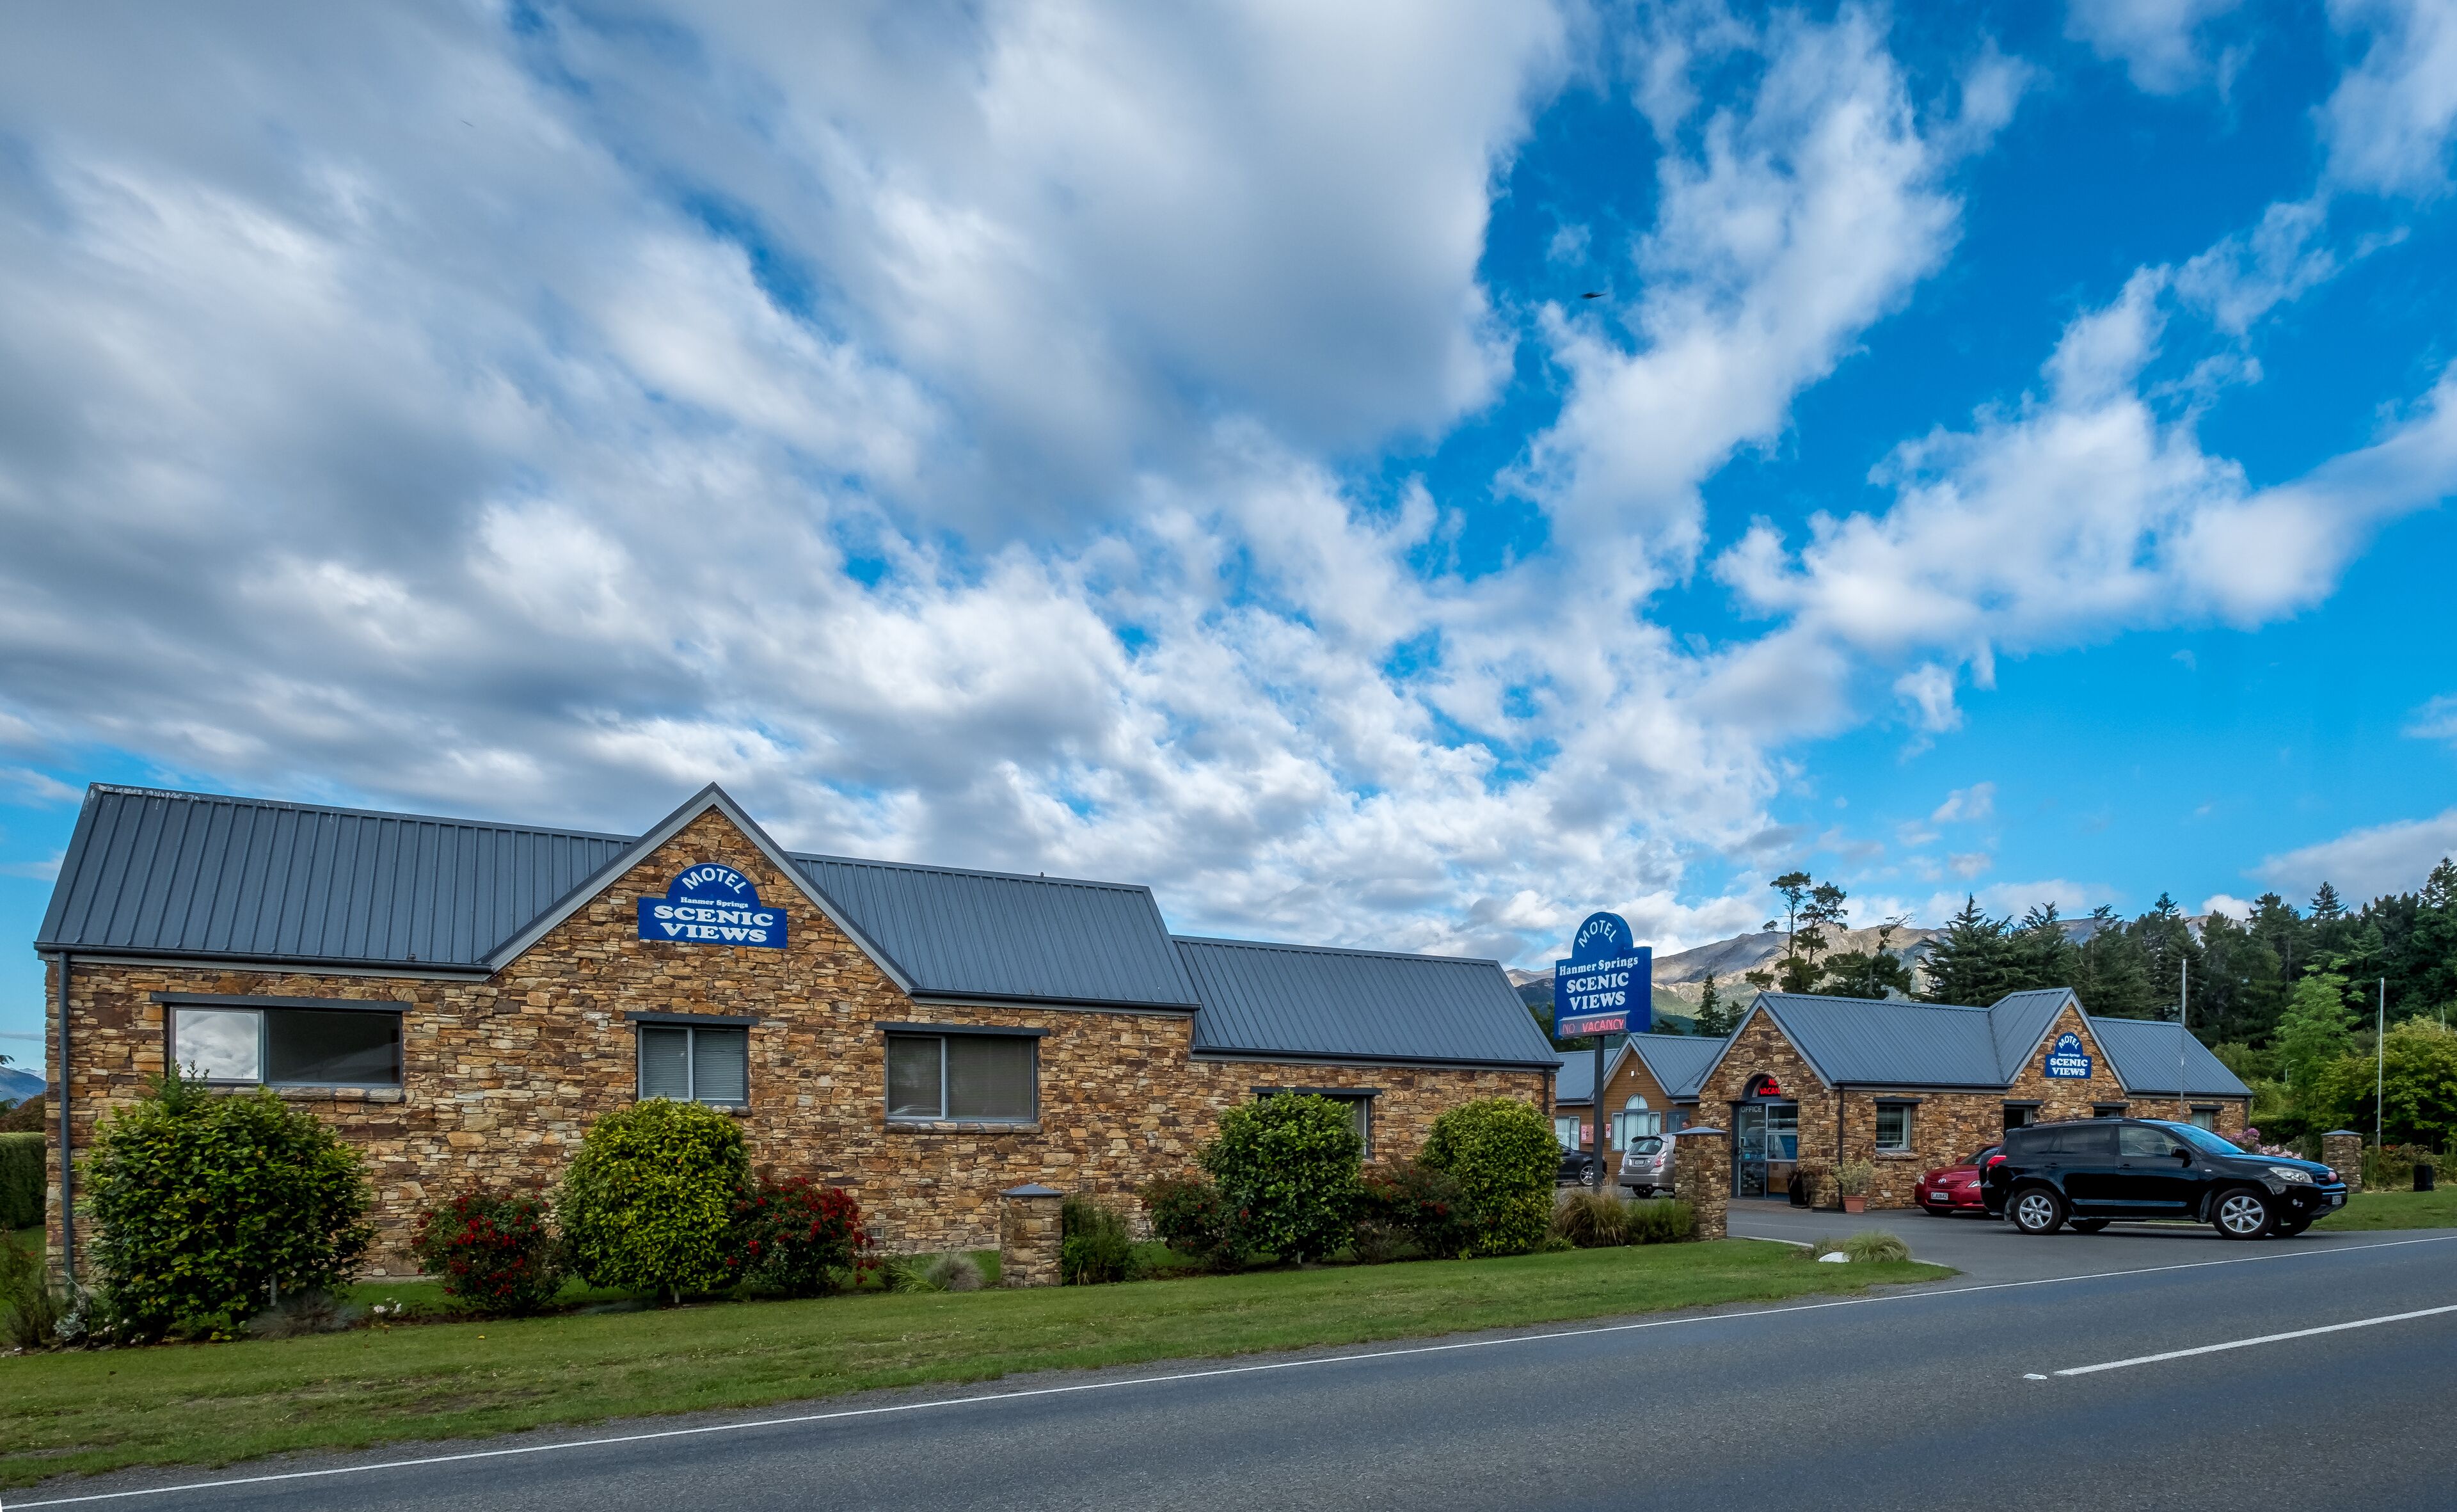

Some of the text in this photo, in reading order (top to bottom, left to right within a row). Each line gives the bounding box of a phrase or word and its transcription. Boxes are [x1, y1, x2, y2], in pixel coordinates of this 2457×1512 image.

[682, 867, 747, 894] MOTEL
[680, 897, 749, 909] Hanmer Springs
[654, 905, 774, 927] SCENIC
[660, 922, 767, 943] VIEWS
[1578, 919, 1617, 948] MOTEL
[1559, 957, 1639, 976] Hanmer Springs
[1566, 973, 1629, 994] SCENIC
[1570, 991, 1626, 1011] VIEWS
[1562, 1019, 1624, 1034] NO VACANCY
[2058, 1035, 2079, 1049] MOTEL
[2050, 1058, 2088, 1067] SCENIC
[2052, 1067, 2085, 1076] VIEWS
